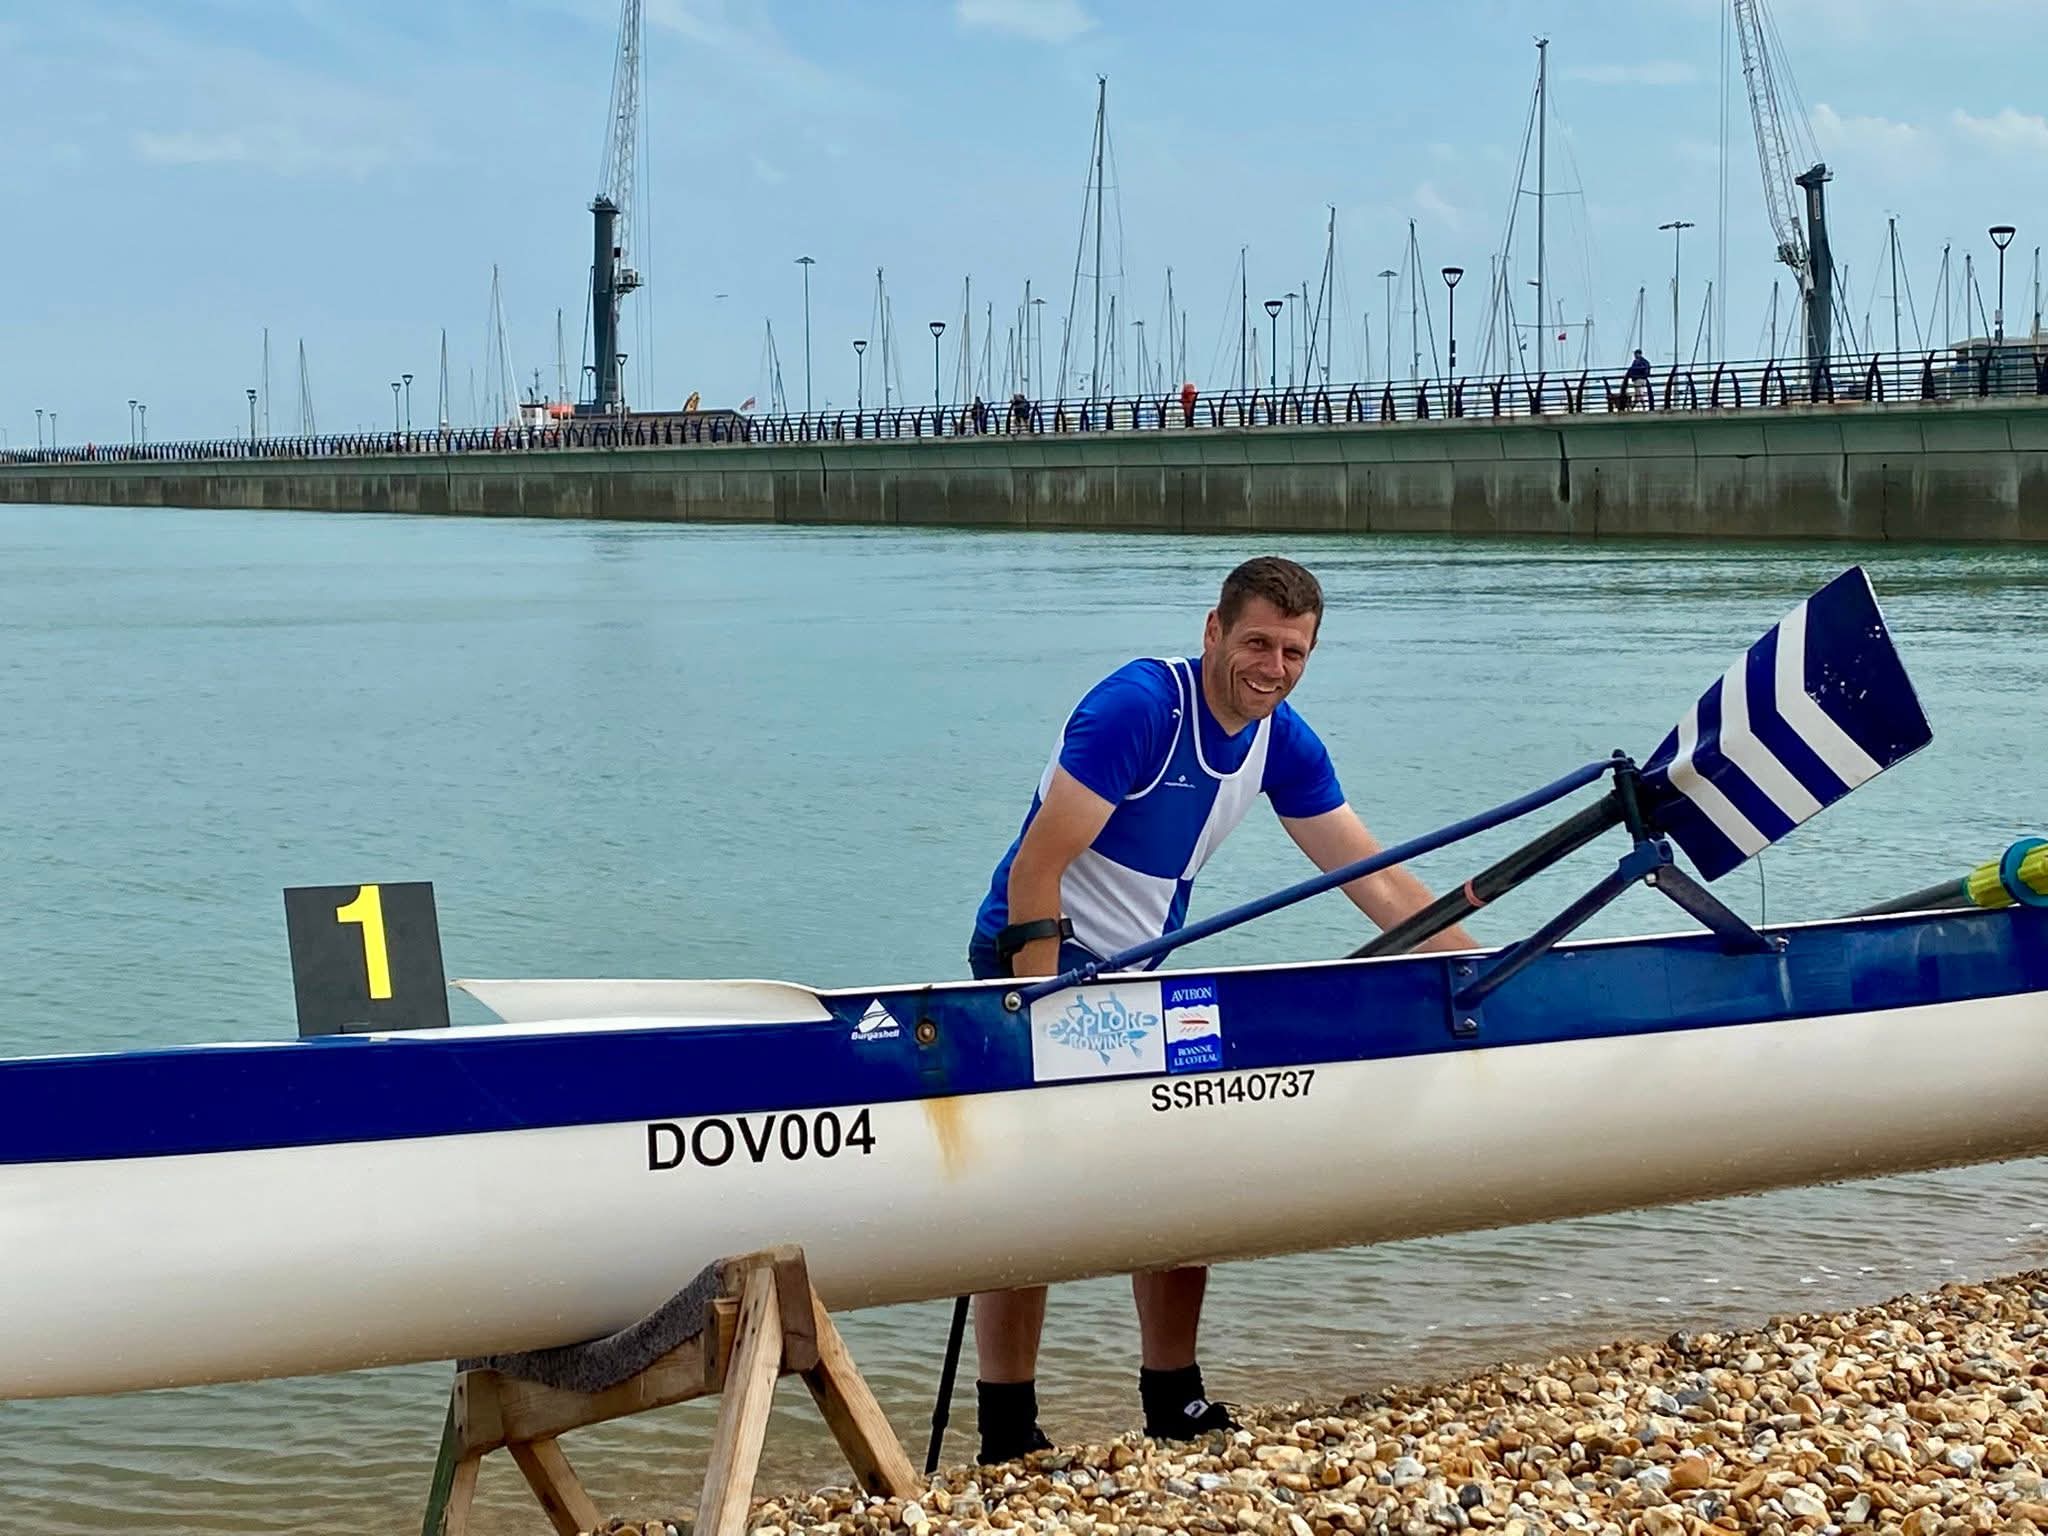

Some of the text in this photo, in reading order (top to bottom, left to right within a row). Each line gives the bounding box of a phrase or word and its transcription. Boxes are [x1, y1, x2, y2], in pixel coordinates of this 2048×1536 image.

[335, 884, 392, 999] 1
[1171, 986, 1213, 1002] AVIRON
[1068, 1031, 1130, 1050] ROWING
[1151, 1069, 1315, 1112] SSR140737
[647, 1108, 876, 1171] DOV004
